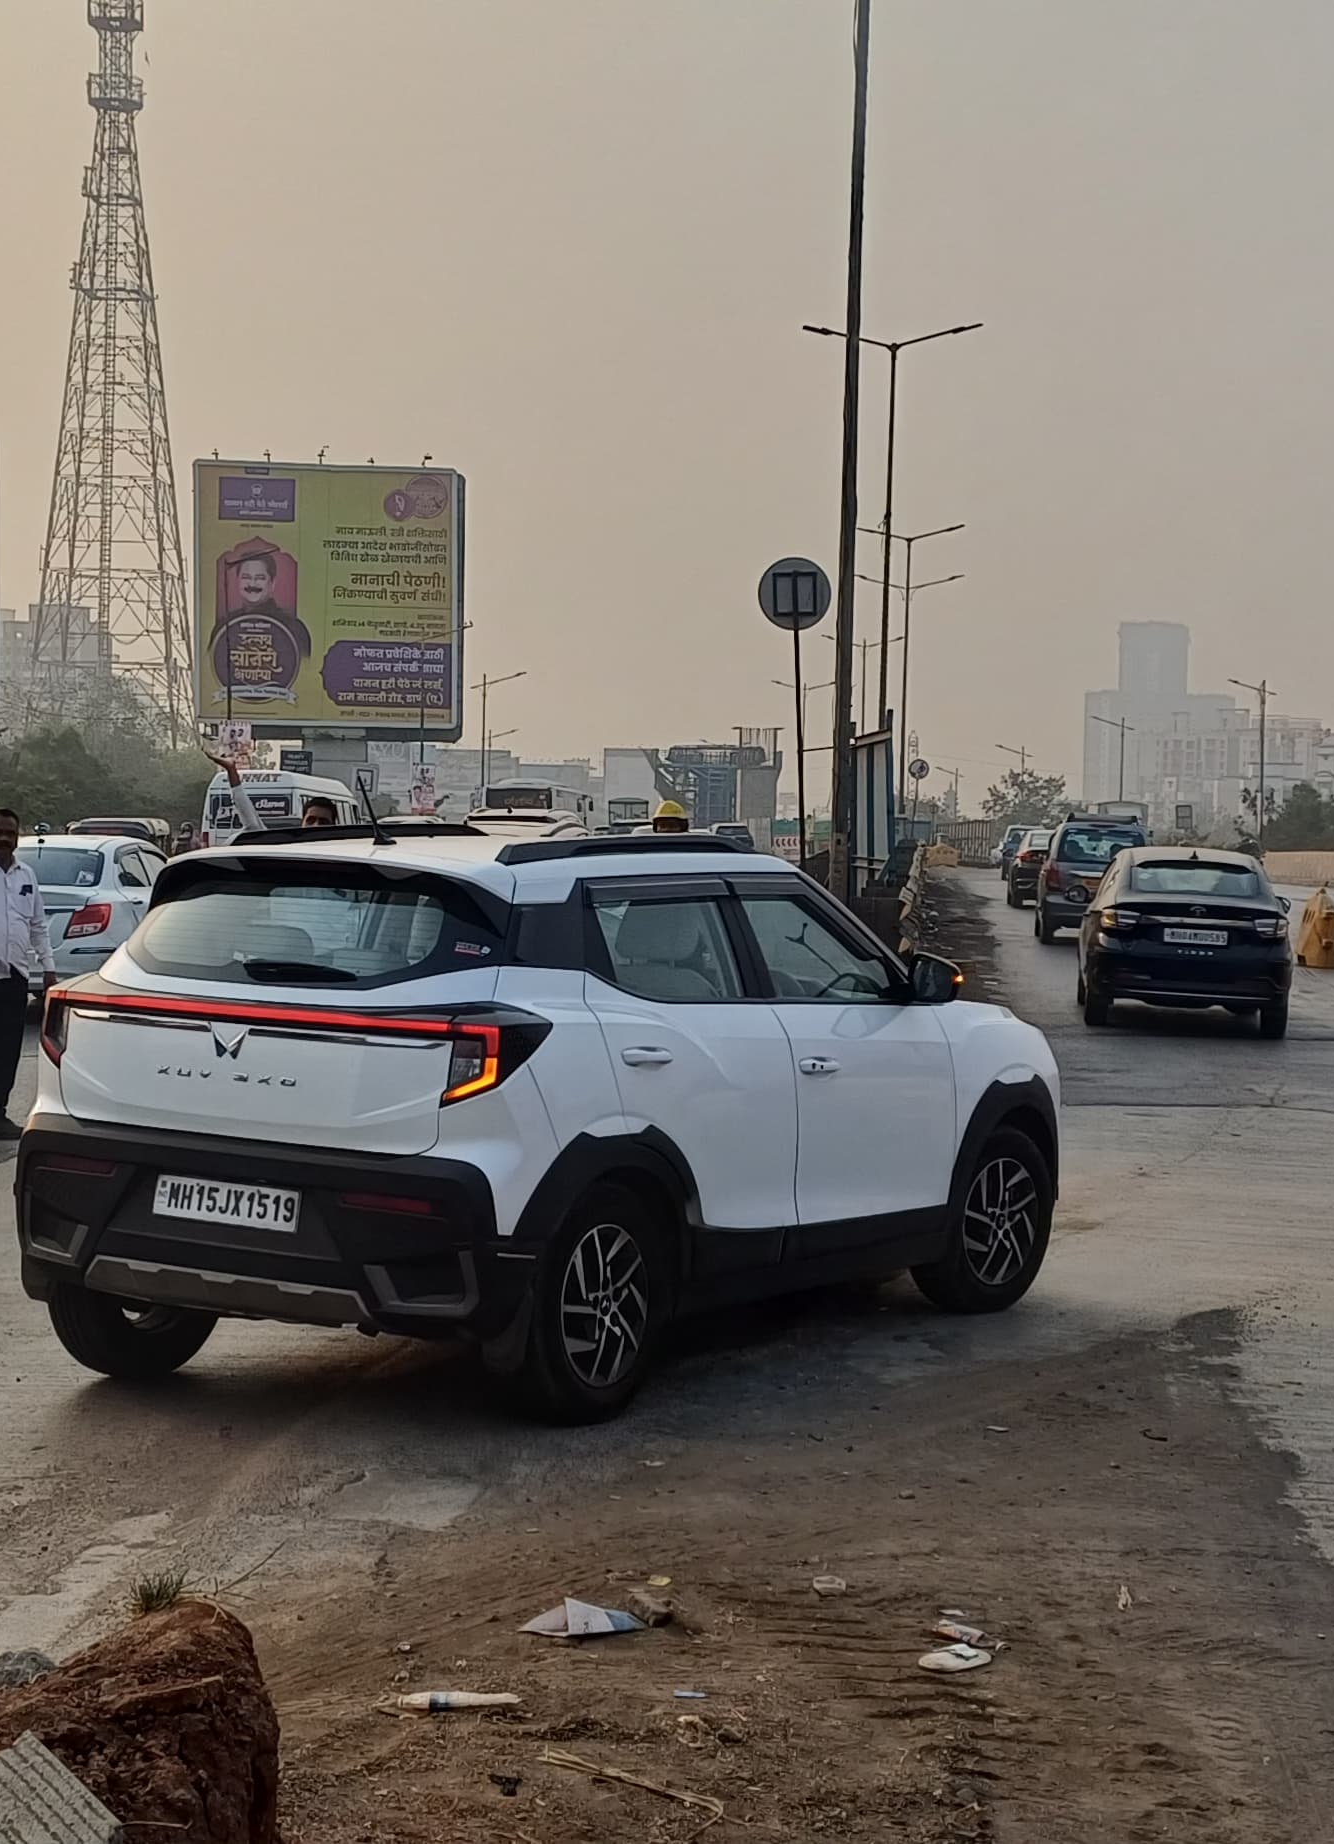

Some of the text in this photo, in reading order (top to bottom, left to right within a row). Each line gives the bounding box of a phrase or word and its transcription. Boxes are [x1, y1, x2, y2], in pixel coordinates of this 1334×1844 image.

[350, 570, 400, 587] मानाची
[157, 1065, 212, 1079] XUV
[166, 1181, 296, 1224] MH15JX1519
